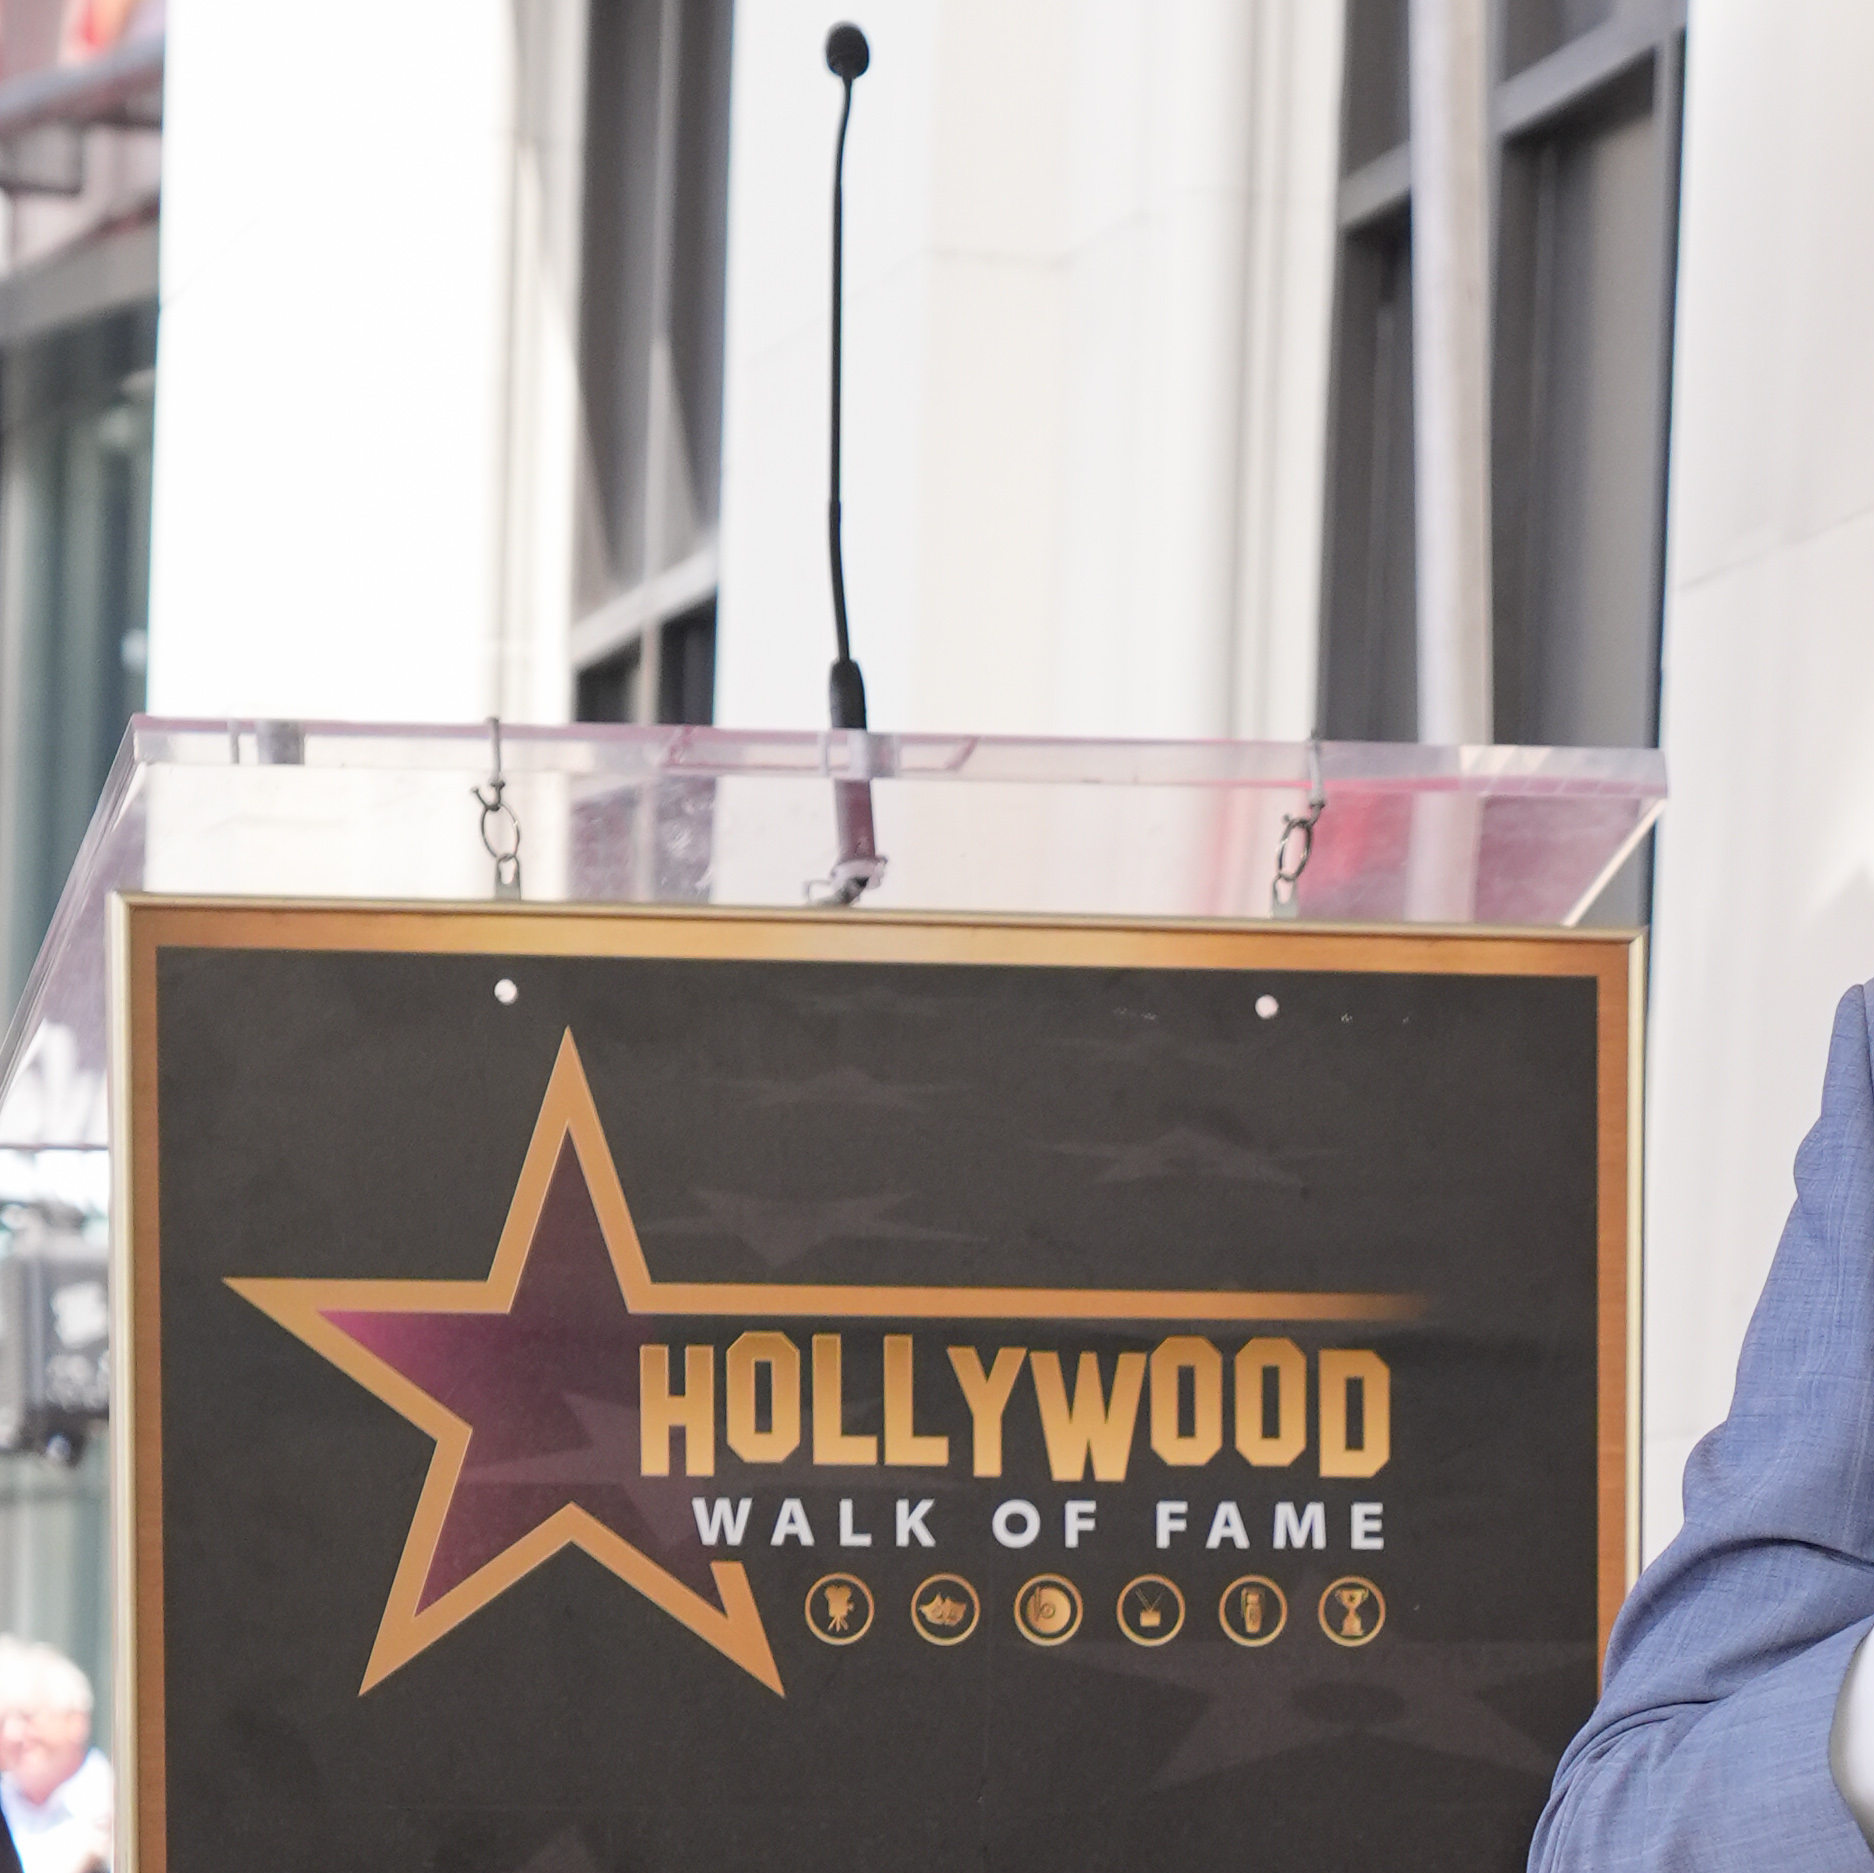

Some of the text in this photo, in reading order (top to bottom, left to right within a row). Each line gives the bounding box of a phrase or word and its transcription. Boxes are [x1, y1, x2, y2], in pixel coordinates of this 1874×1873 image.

[640, 1332, 1389, 1481] HOLLYWOOD
[692, 1498, 1386, 1549] WALK OF FAME
